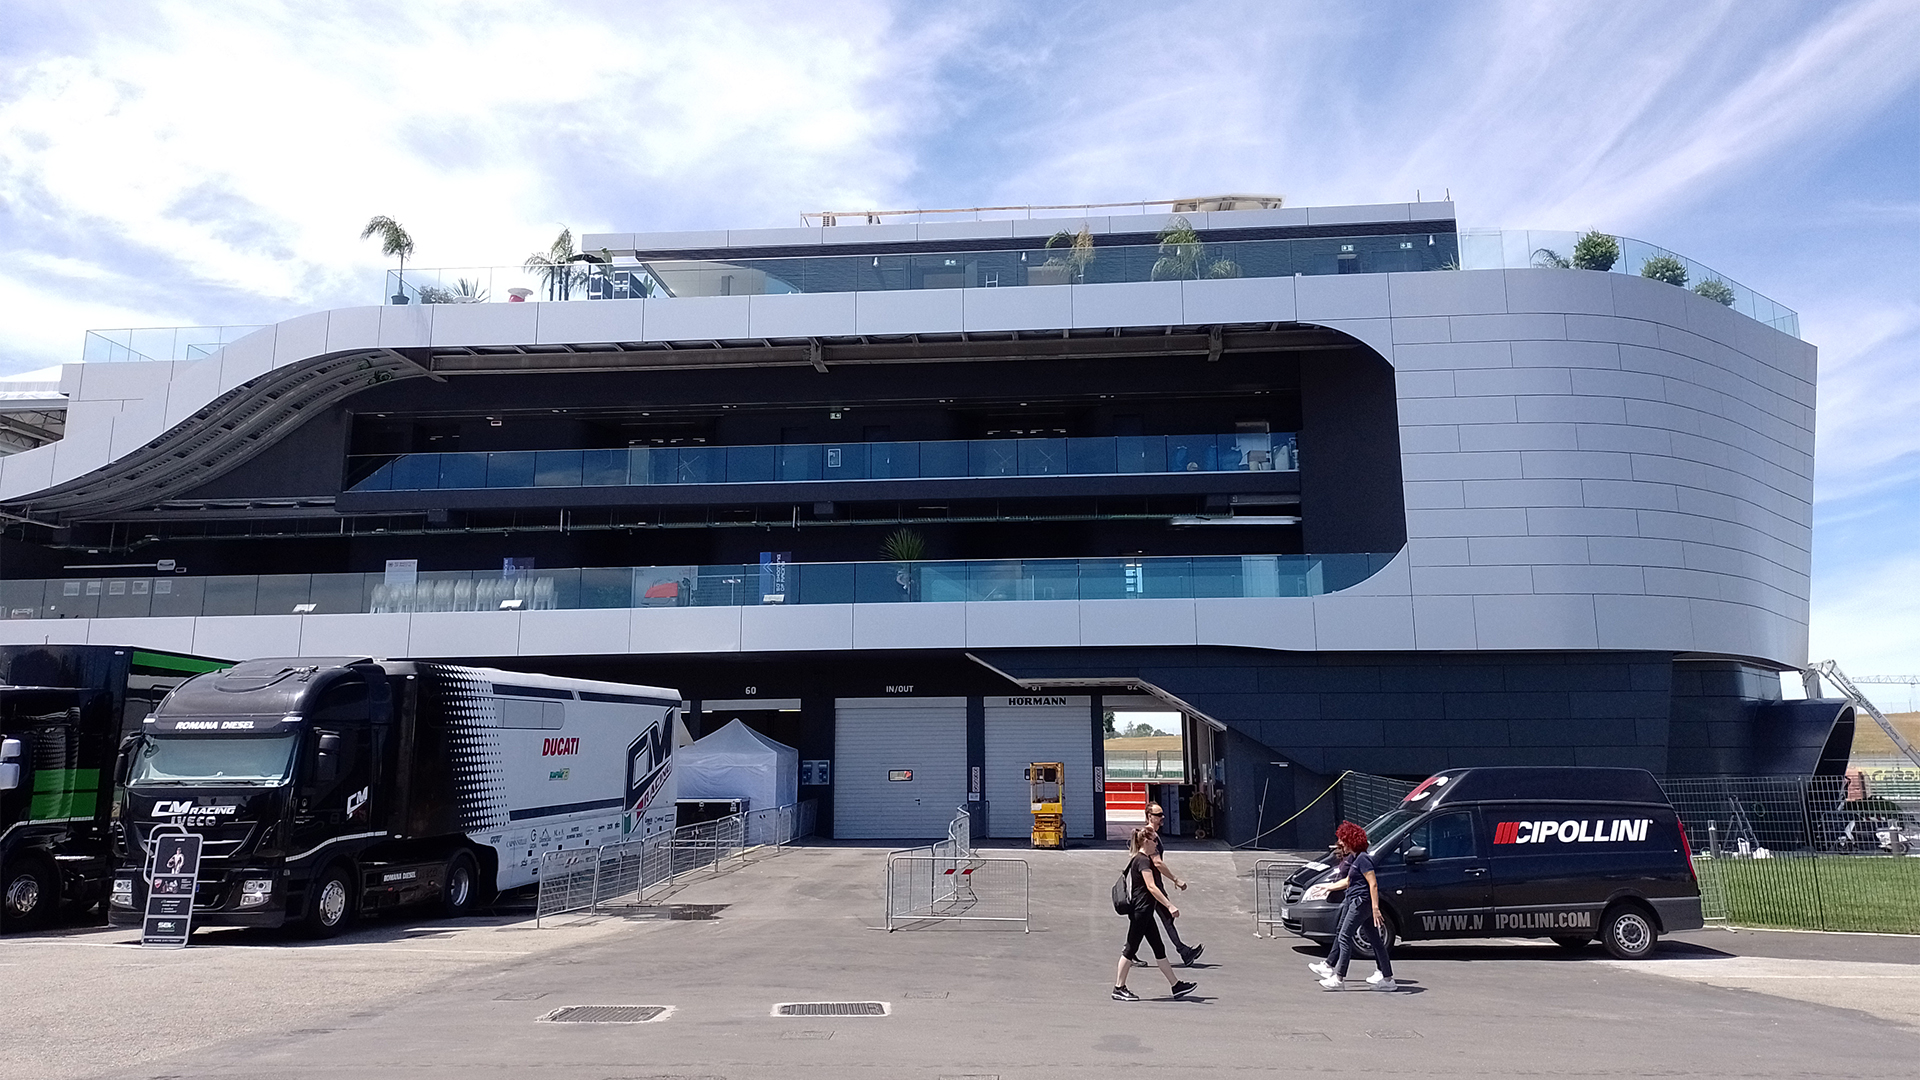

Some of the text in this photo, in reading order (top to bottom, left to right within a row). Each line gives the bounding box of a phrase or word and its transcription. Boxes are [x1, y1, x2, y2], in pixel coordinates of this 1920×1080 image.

[745, 686, 757, 695] 60
[885, 685, 914, 694] IN/OUT
[175, 720, 255, 730] ROMANA DIESEL
[542, 737, 580, 757] DUCATI
[643, 762, 673, 806] RACING
[151, 800, 237, 817] CM RACING
[171, 815, 217, 827] IVECO
[1515, 819, 1650, 844] CIPOLLINI
